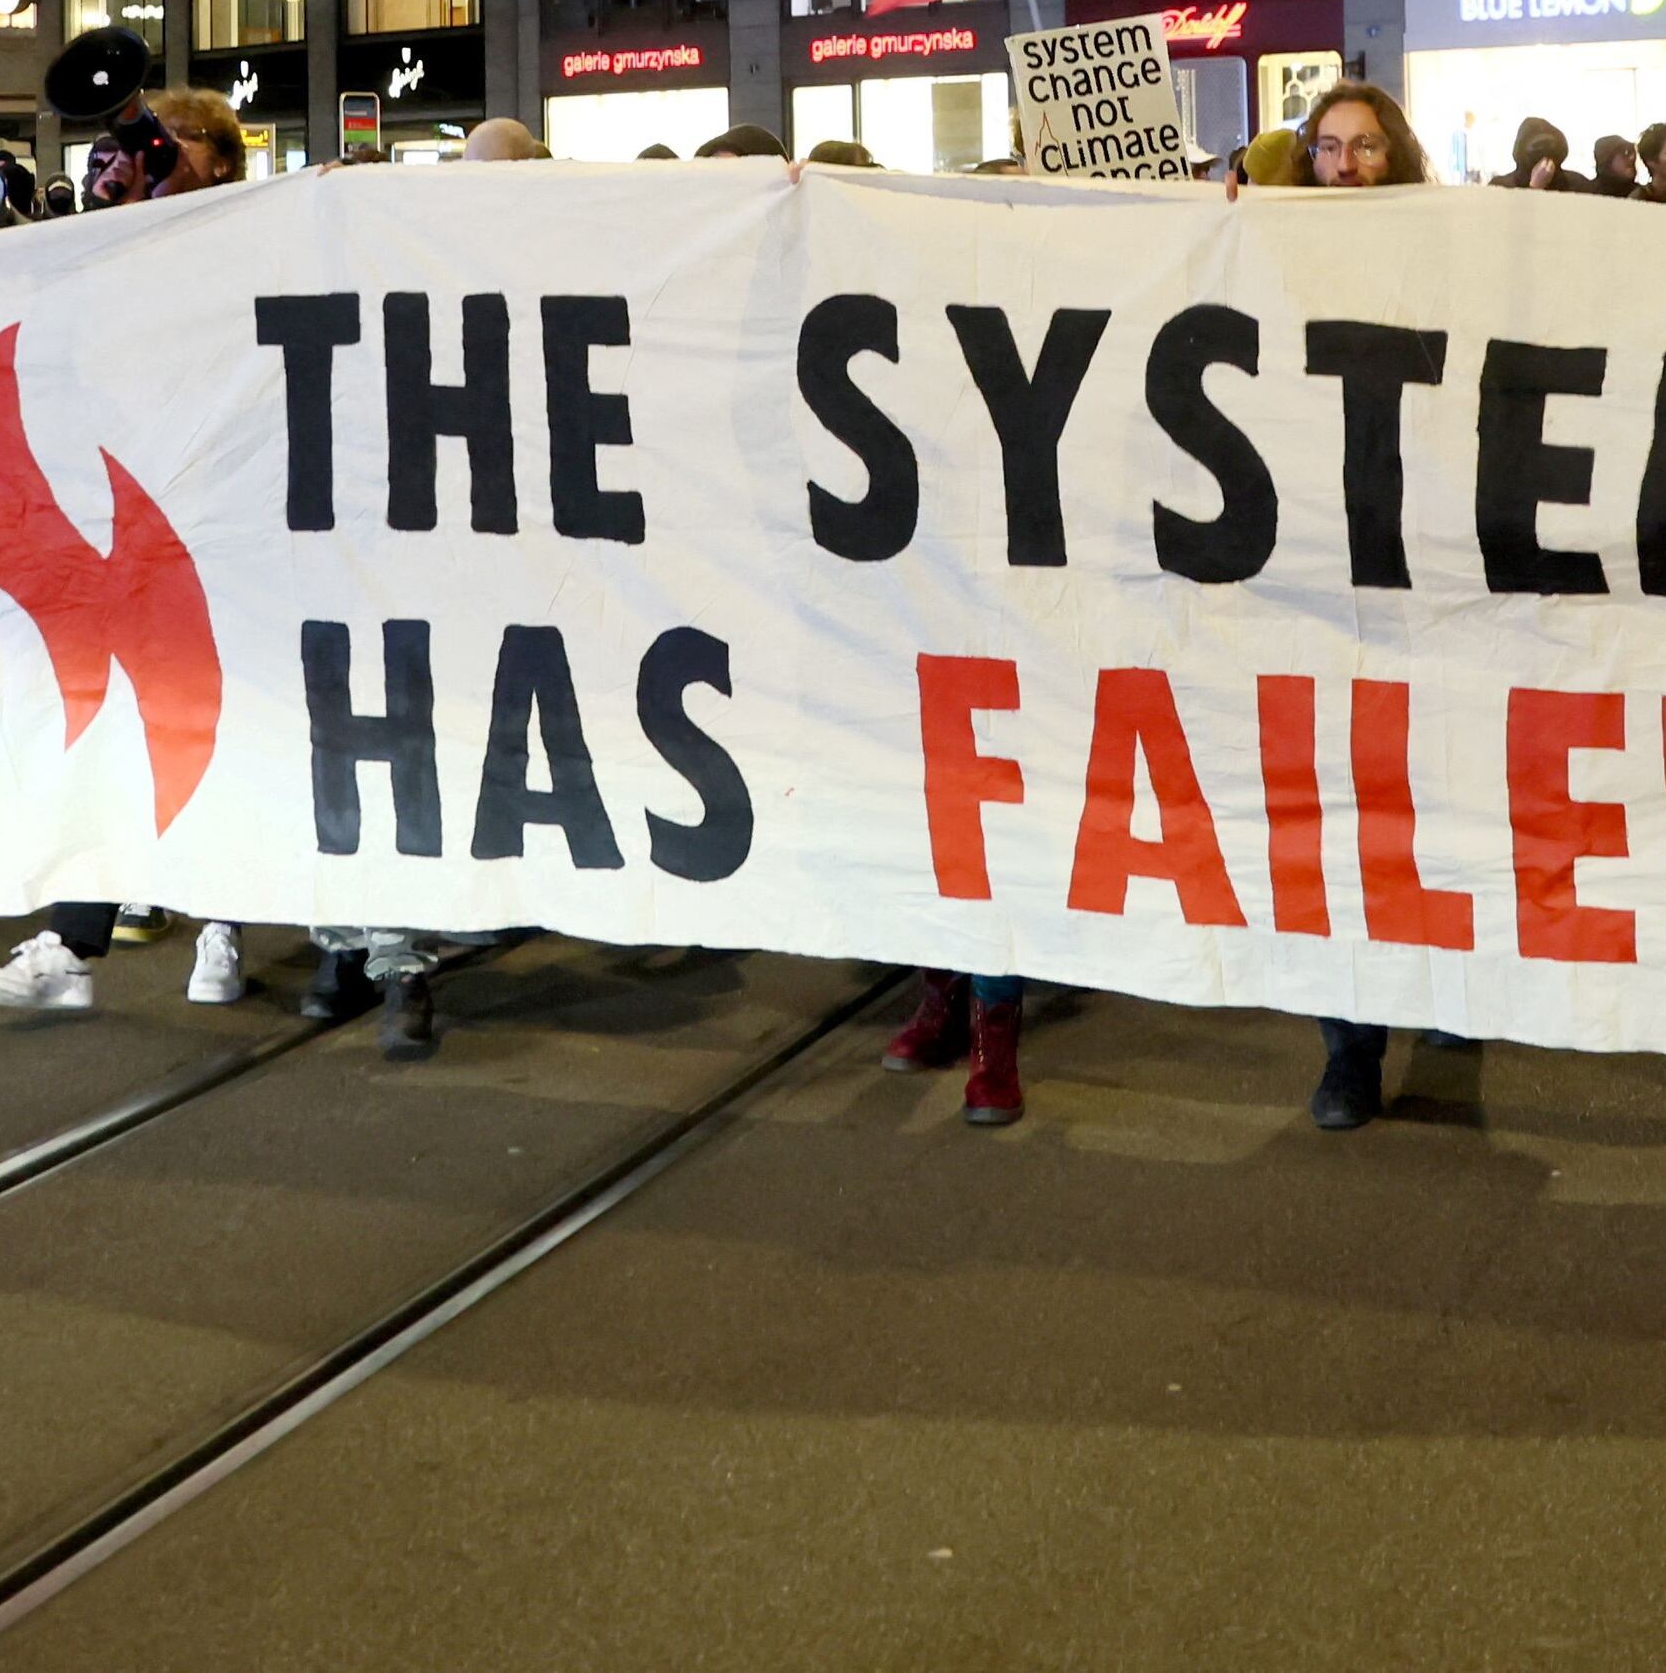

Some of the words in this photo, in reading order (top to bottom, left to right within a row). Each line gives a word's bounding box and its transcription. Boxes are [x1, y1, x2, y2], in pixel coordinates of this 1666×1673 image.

[563, 50, 610, 77] galerie
[613, 44, 700, 74] gmurzynska
[811, 33, 867, 62] galerie
[870, 27, 974, 59] gmurzynska
[1023, 24, 1152, 70] system
[1071, 95, 1133, 132] not
[255, 291, 645, 545] THE
[301, 619, 754, 882] HAS
